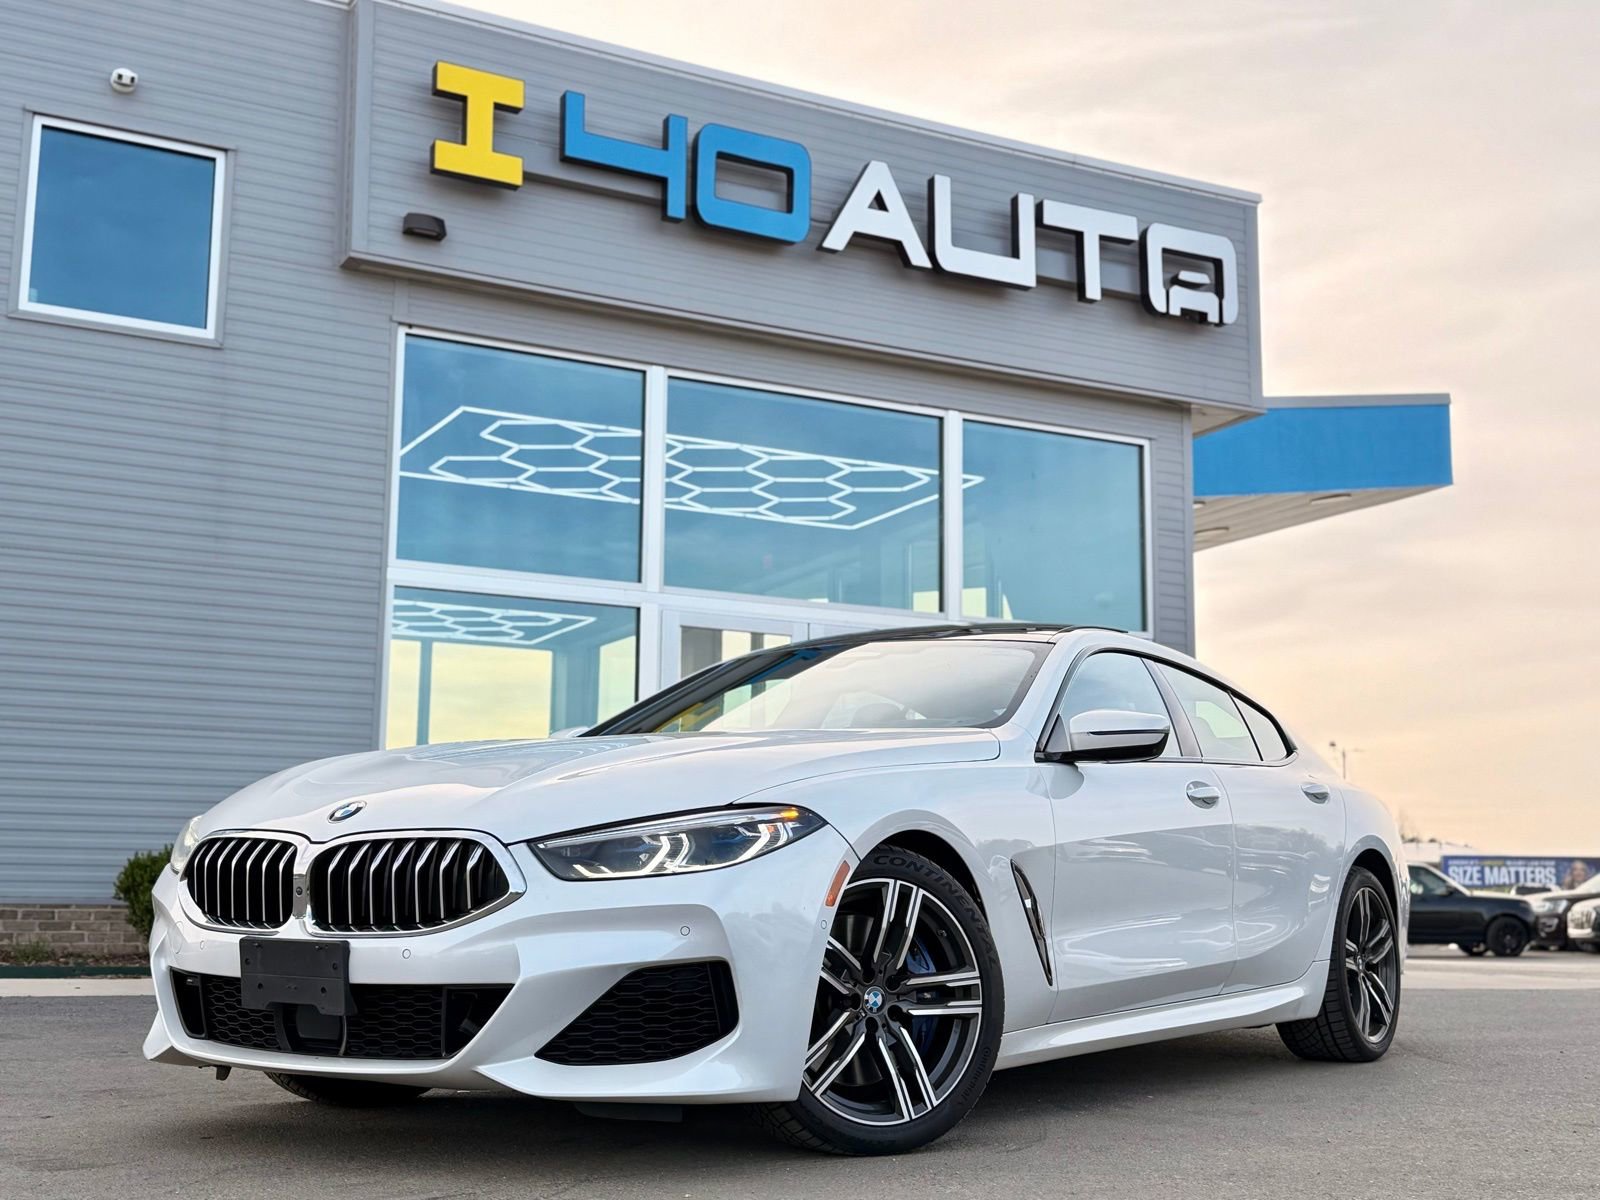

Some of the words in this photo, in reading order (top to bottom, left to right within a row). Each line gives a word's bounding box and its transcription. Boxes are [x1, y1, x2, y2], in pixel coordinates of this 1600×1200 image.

[1448, 866, 1482, 885] SIZE
[1484, 866, 1557, 885] MATTERS
[873, 855, 998, 964] CONTINENTAL
